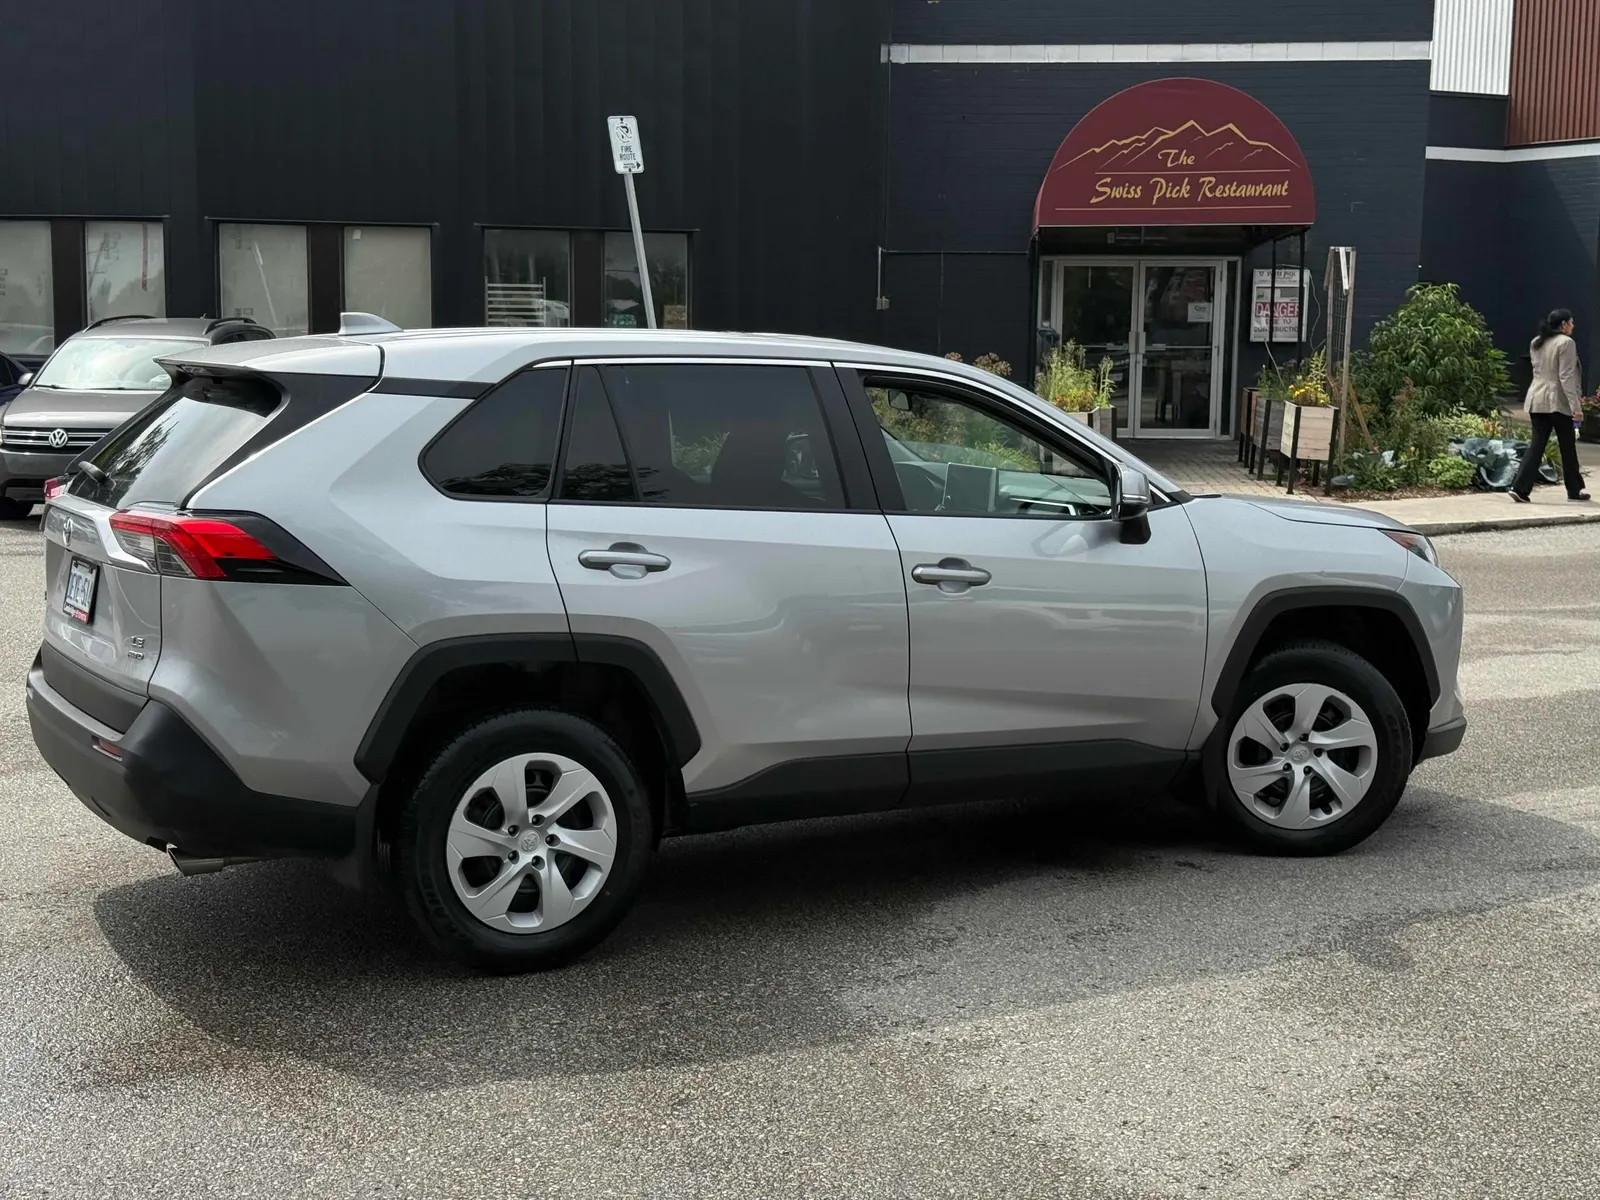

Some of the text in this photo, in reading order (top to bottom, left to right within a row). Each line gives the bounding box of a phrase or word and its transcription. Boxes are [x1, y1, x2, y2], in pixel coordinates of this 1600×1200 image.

[1157, 149, 1195, 168] The
[1089, 176, 1289, 206] Swiss Pick Restaurant
